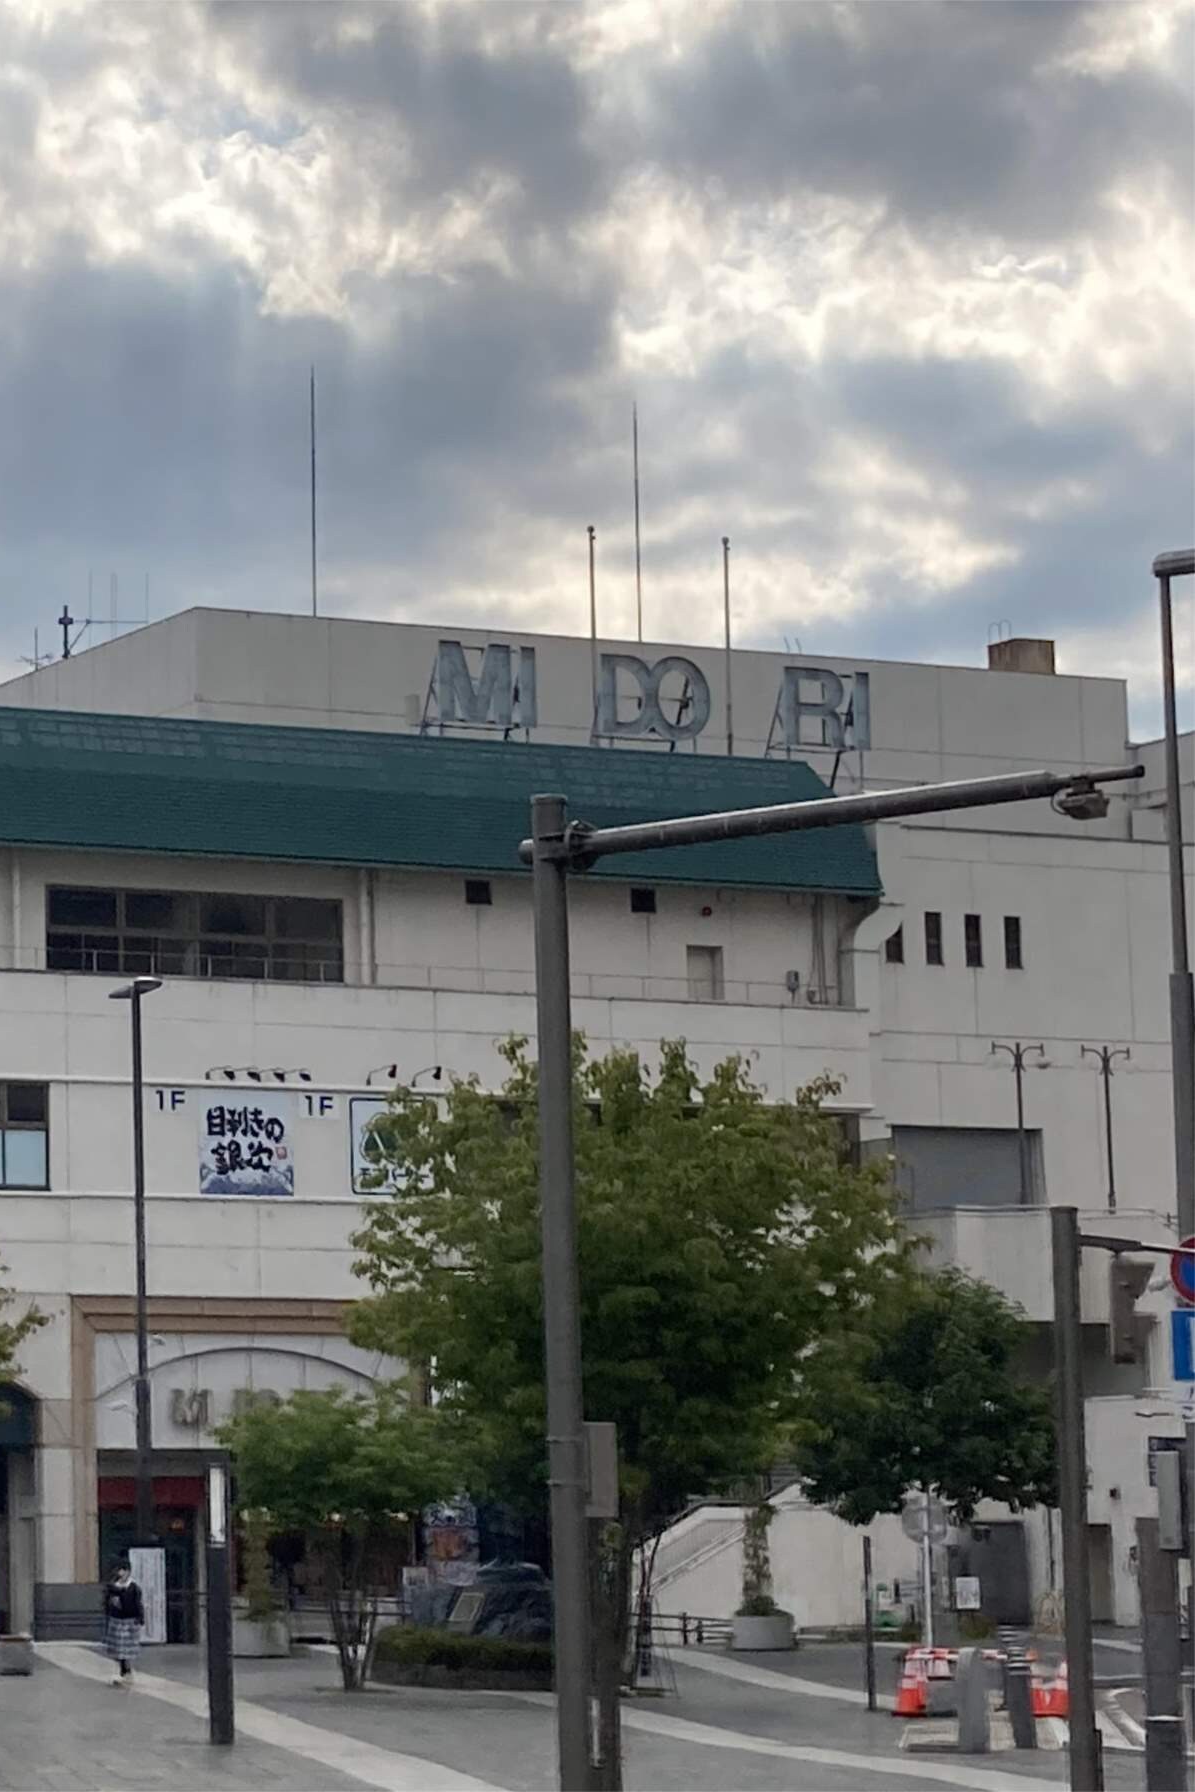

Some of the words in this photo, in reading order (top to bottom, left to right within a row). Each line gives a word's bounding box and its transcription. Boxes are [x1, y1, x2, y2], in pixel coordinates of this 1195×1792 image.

[438, 639, 537, 729] MI
[599, 652, 712, 740] DO
[783, 665, 872, 751] RI
[155, 1090, 186, 1112] 1F
[305, 1095, 334, 1117] 1F
